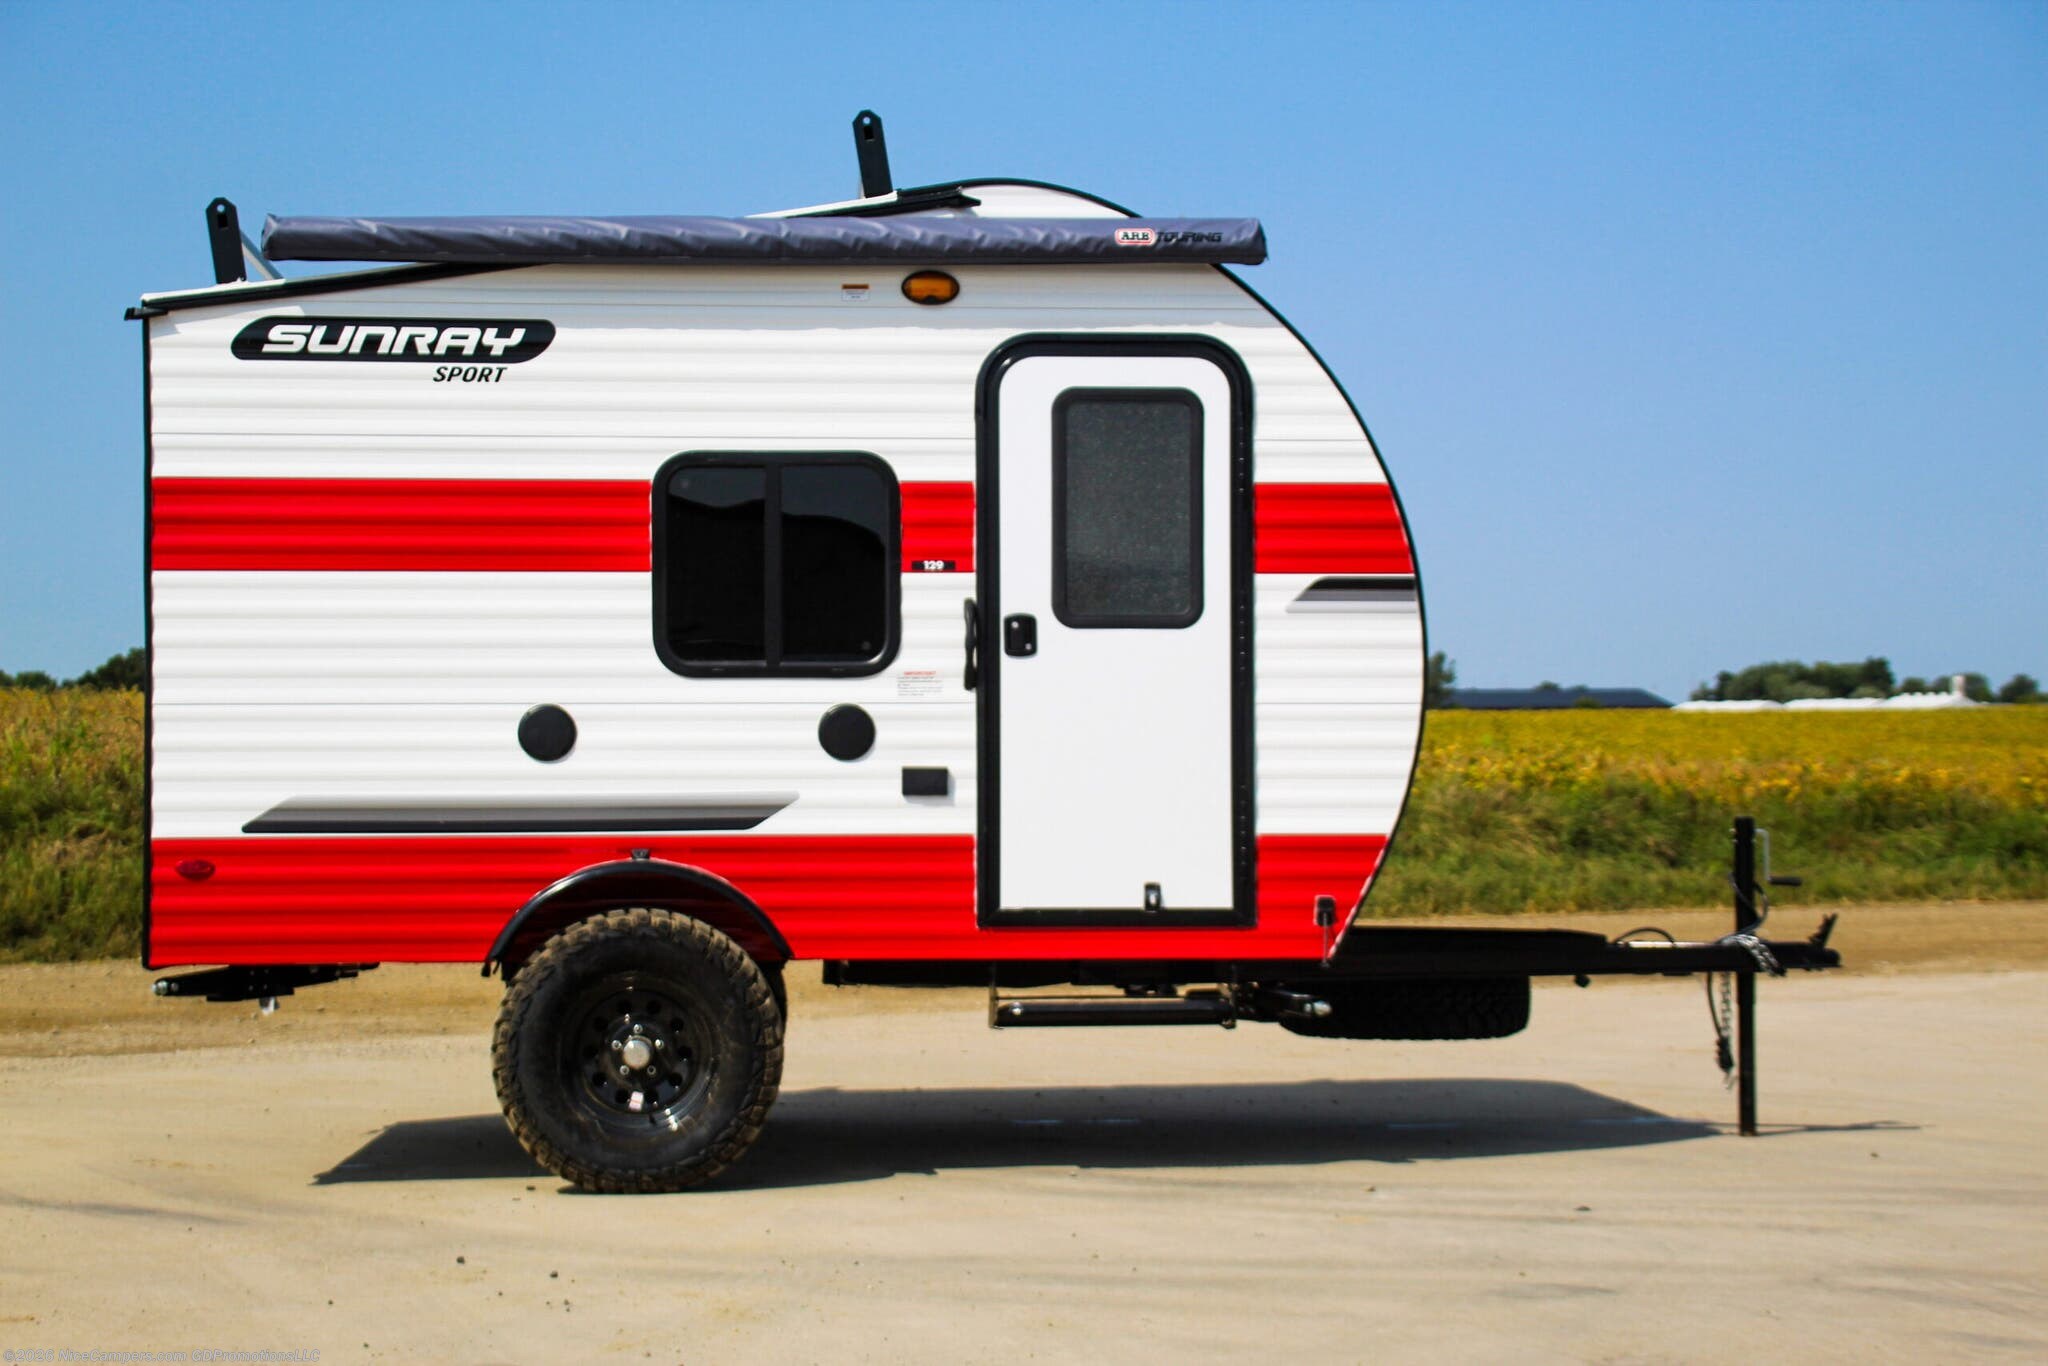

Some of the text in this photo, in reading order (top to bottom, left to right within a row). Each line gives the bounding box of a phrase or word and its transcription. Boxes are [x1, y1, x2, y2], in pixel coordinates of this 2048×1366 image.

[1121, 231, 1222, 242] ARB TOURING
[261, 324, 526, 356] SUNRAY
[433, 366, 507, 383] SPORT
[924, 560, 945, 570] 129
